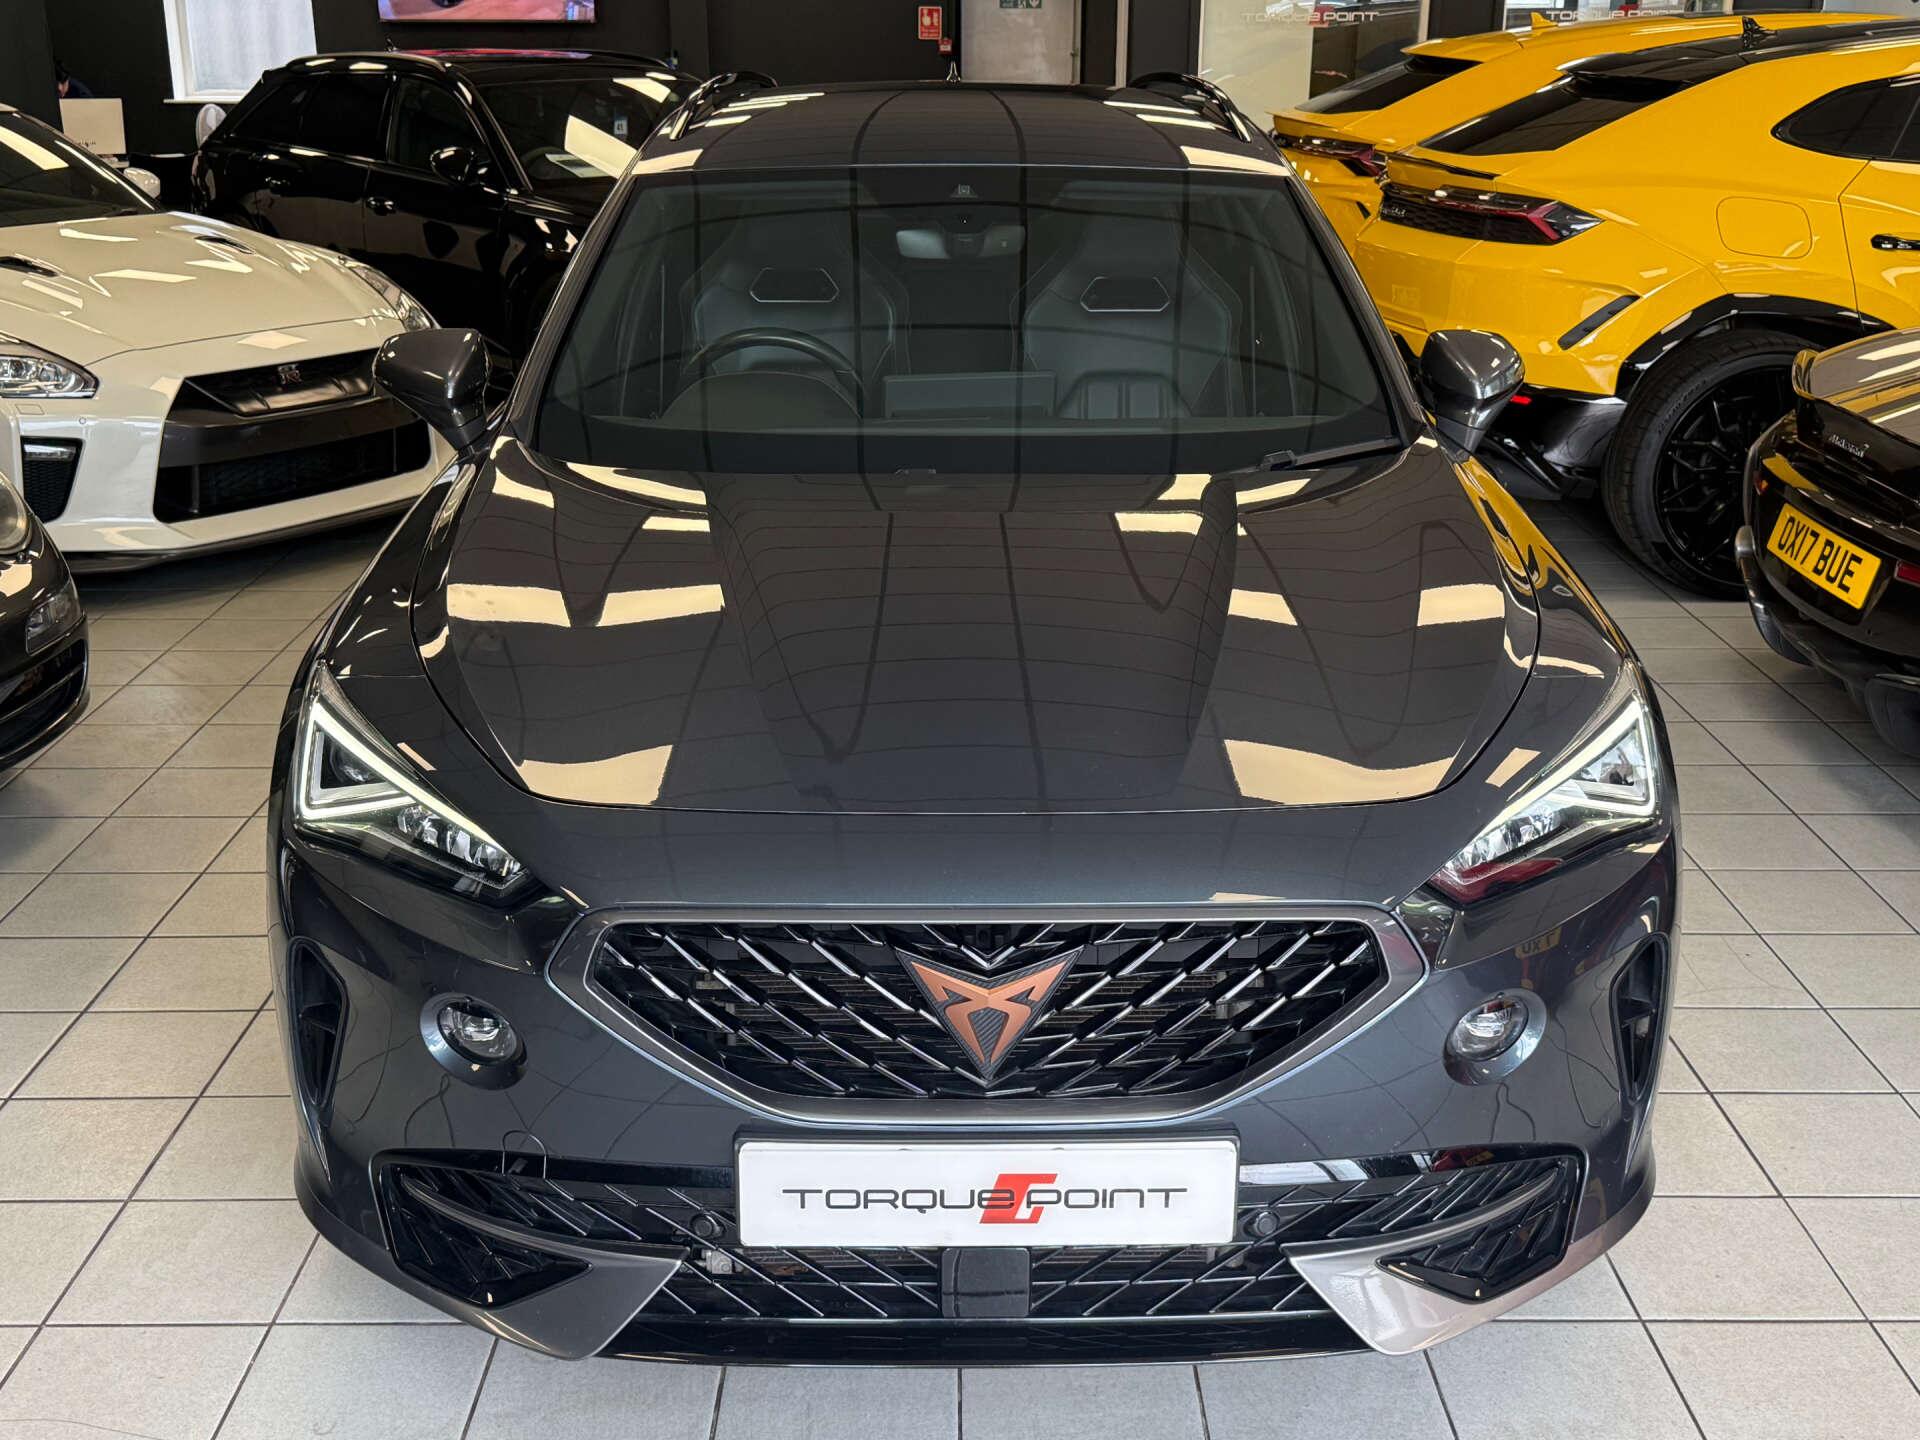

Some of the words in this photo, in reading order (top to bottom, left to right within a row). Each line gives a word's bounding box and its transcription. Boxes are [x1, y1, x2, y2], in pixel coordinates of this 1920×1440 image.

[1323, 11, 1379, 22] POINT
[1777, 516, 1820, 565] OX17
[1812, 538, 1863, 594] BUE
[782, 1189, 1015, 1214] TORQUE
[1026, 1188, 1188, 1209] POINT
